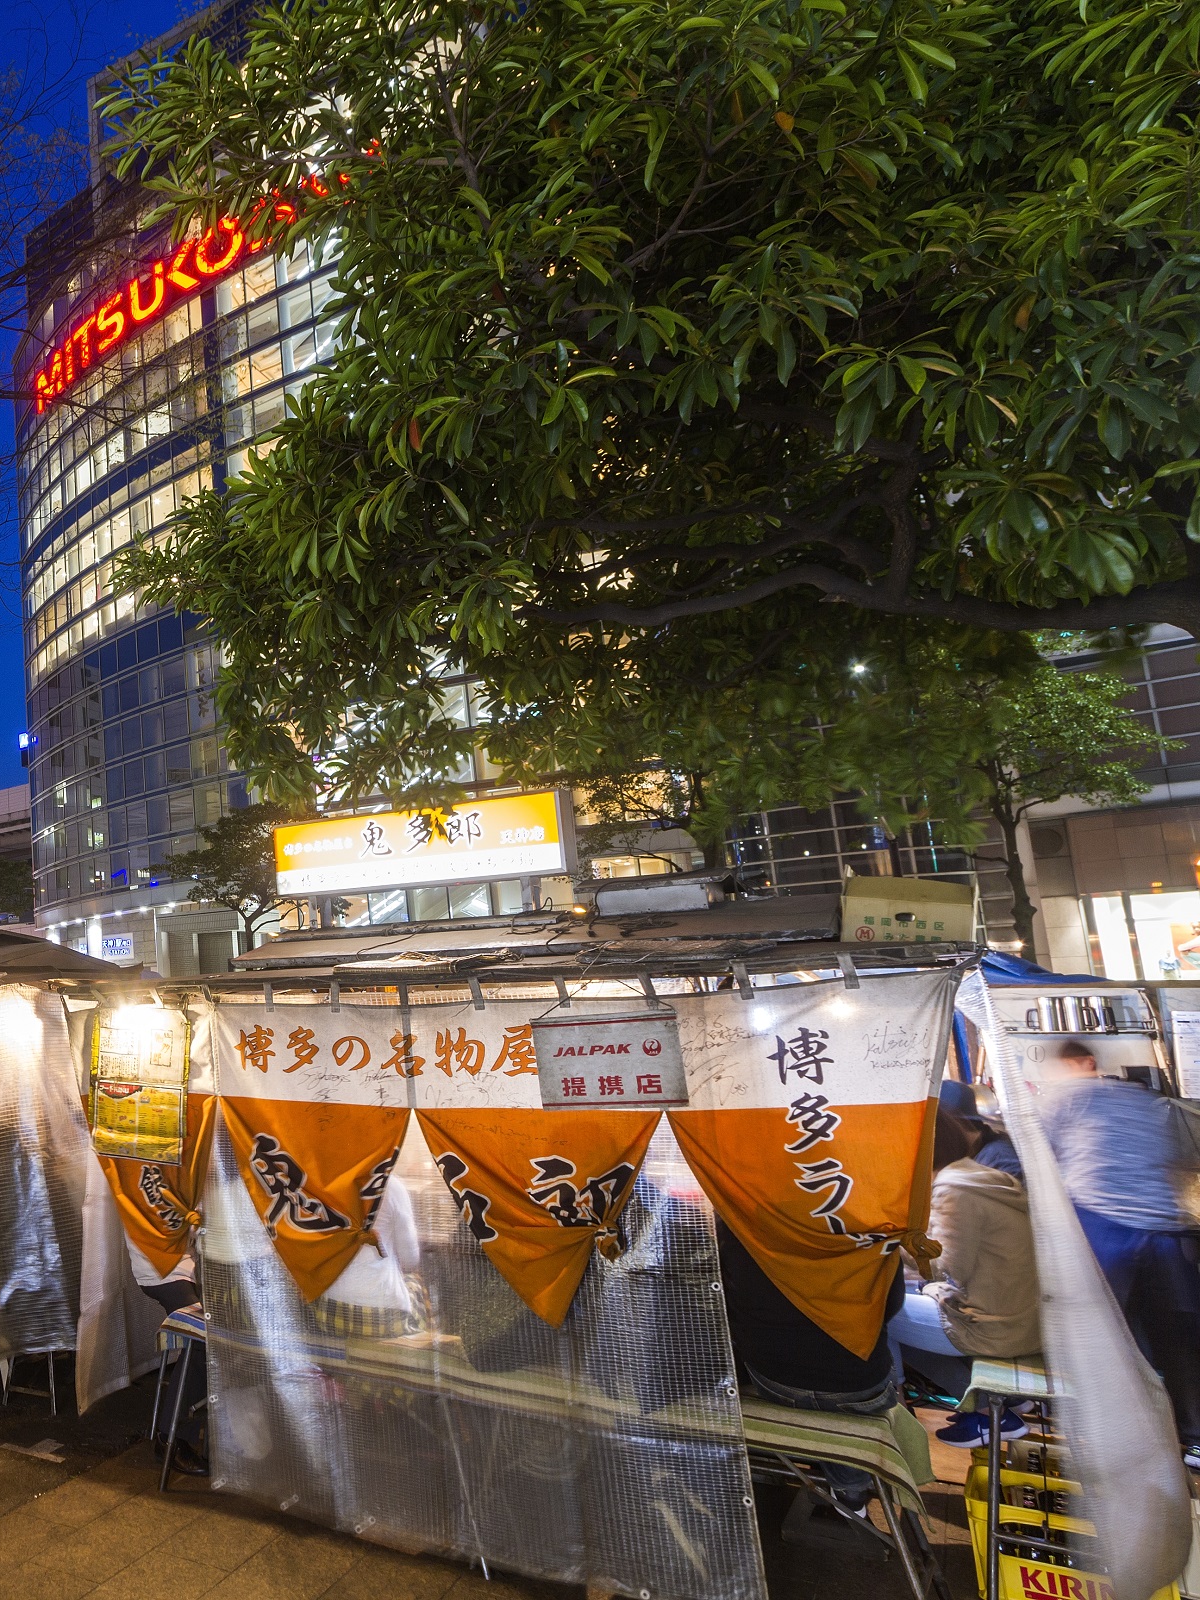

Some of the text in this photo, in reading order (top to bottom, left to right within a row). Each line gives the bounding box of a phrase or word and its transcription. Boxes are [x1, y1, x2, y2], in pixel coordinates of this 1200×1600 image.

[36, 172, 350, 416] MITSUKO
[864, 916, 944, 930] 福岡市西区
[553, 1043, 632, 1057] JALPAK
[562, 1074, 662, 1097] 提携店
